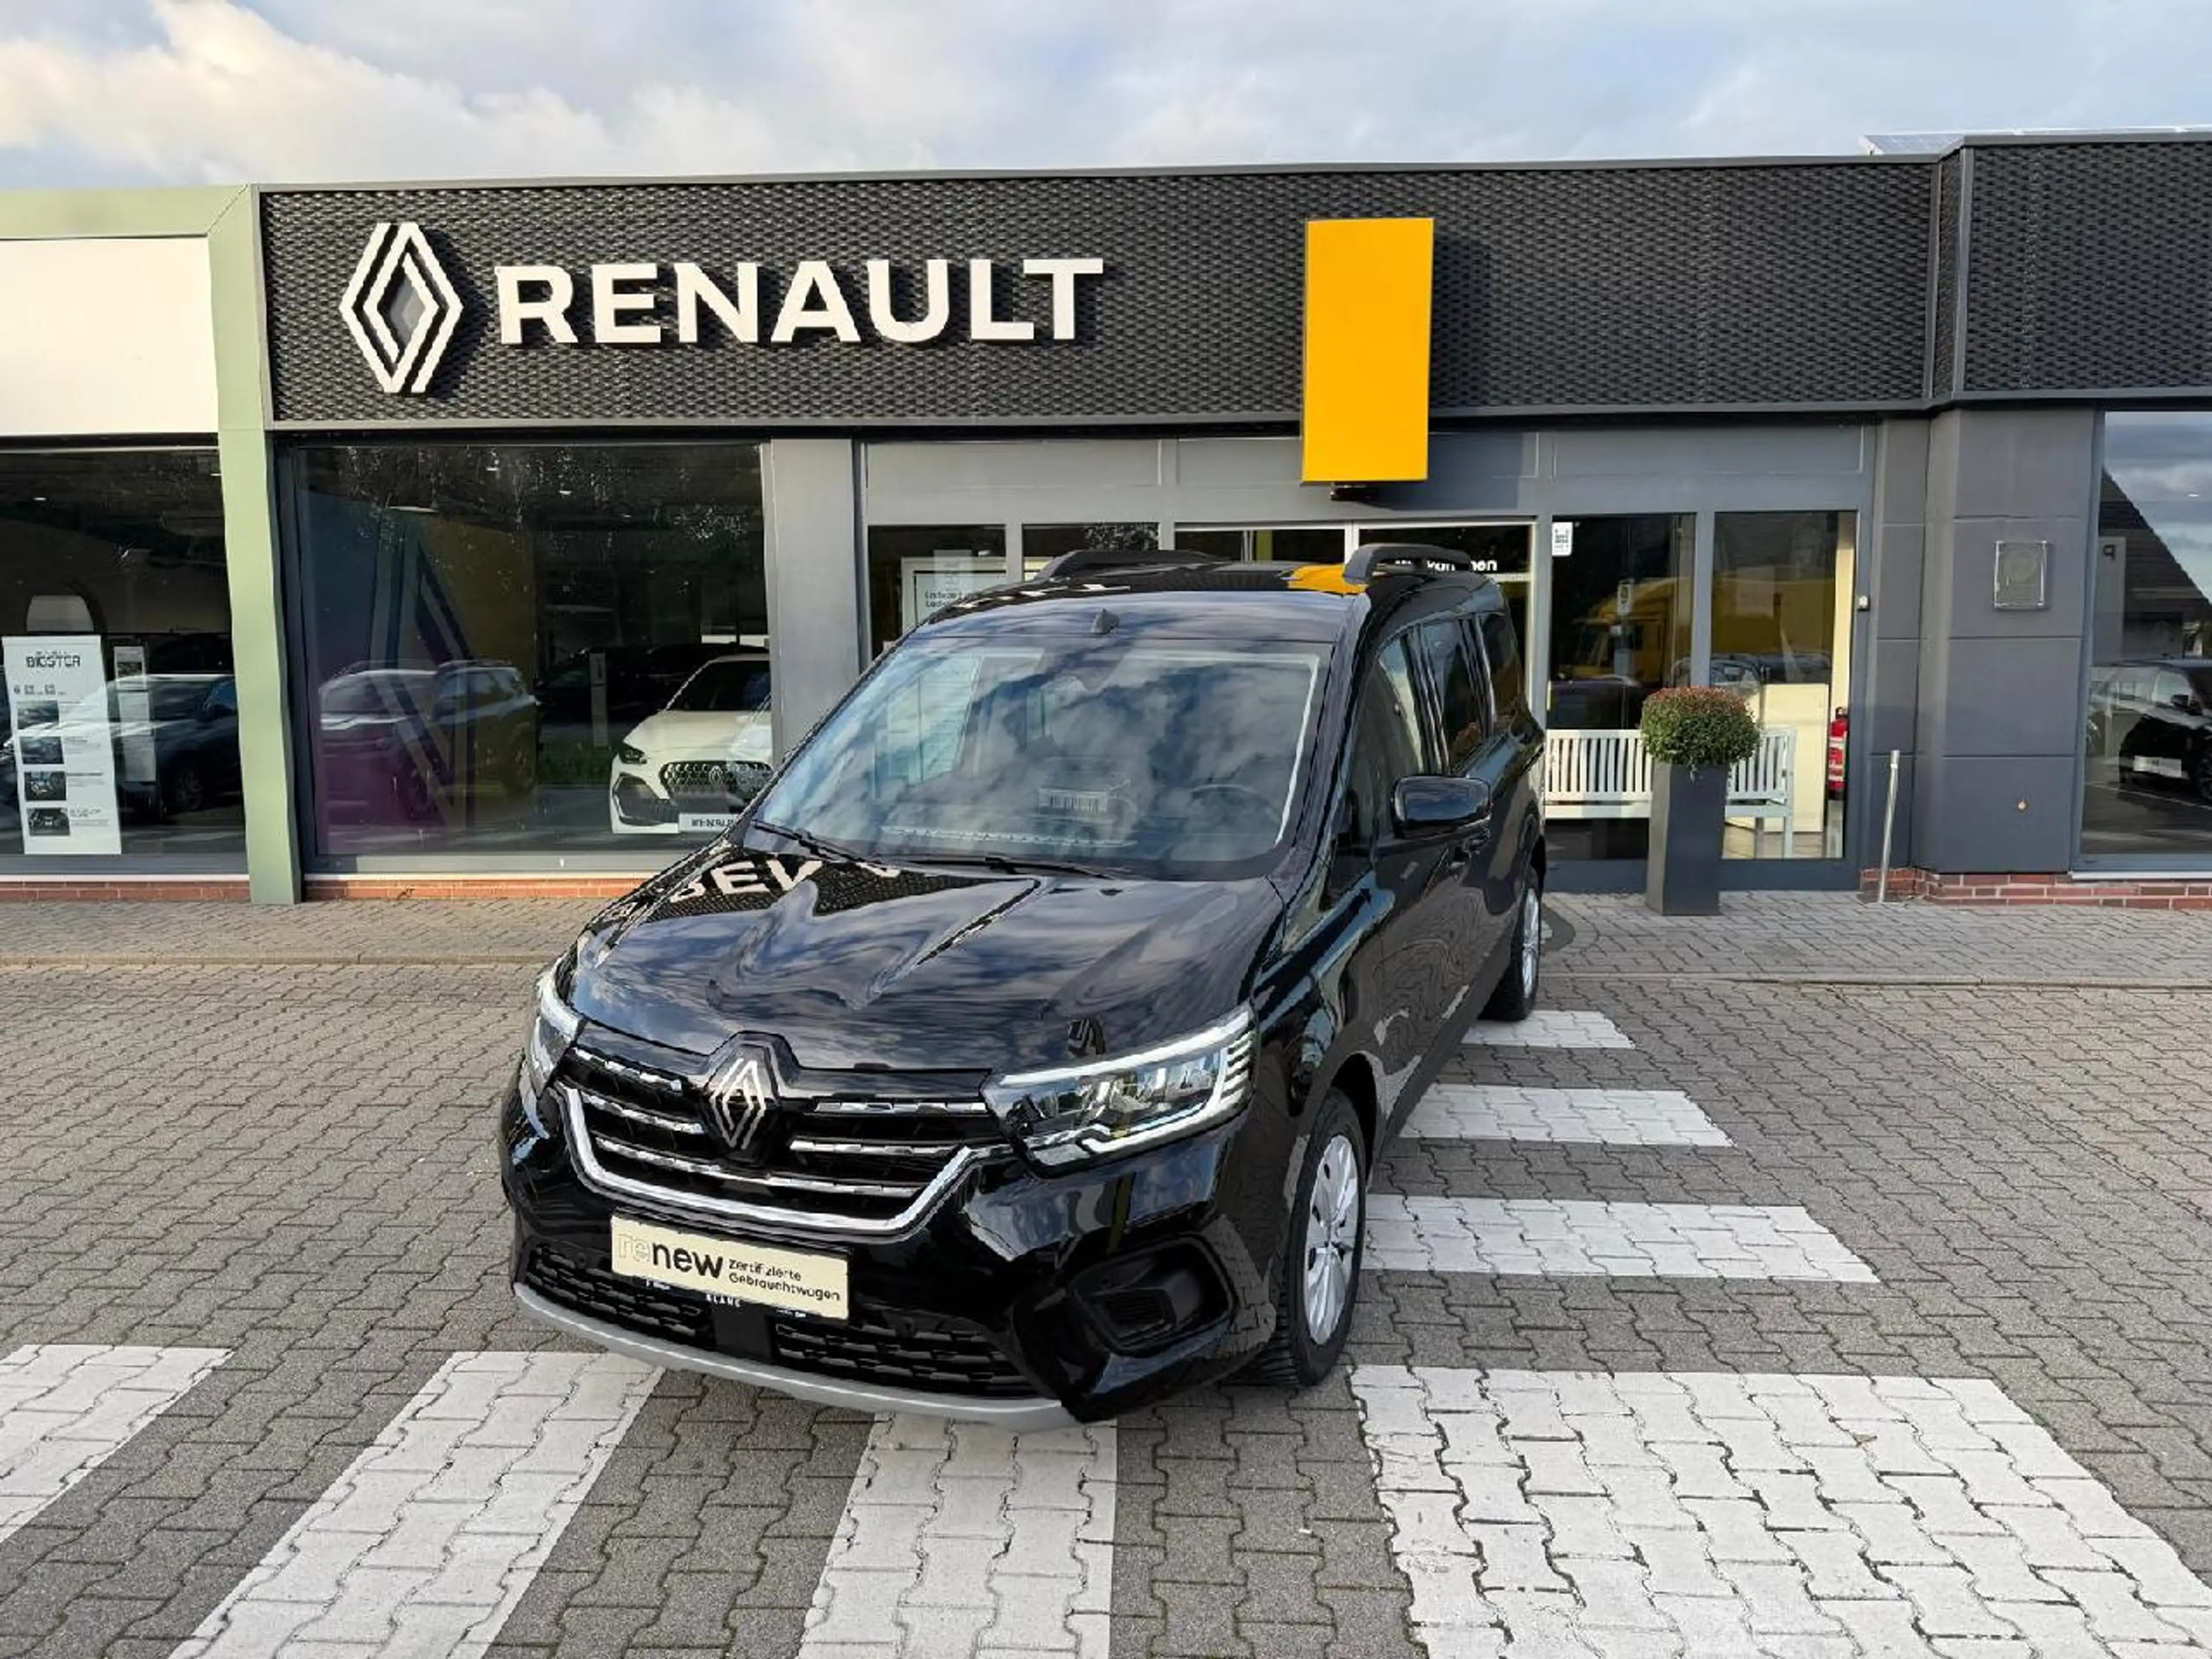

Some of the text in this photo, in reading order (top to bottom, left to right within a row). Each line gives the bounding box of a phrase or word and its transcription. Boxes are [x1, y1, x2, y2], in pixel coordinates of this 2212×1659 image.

[494, 258, 1104, 346] RENAULT
[26, 654, 81, 668] BIGSTER
[616, 1234, 724, 1279] renew
[728, 1258, 802, 1281] Zertifizierte
[728, 1272, 841, 1301] Gebrauchtwagen
